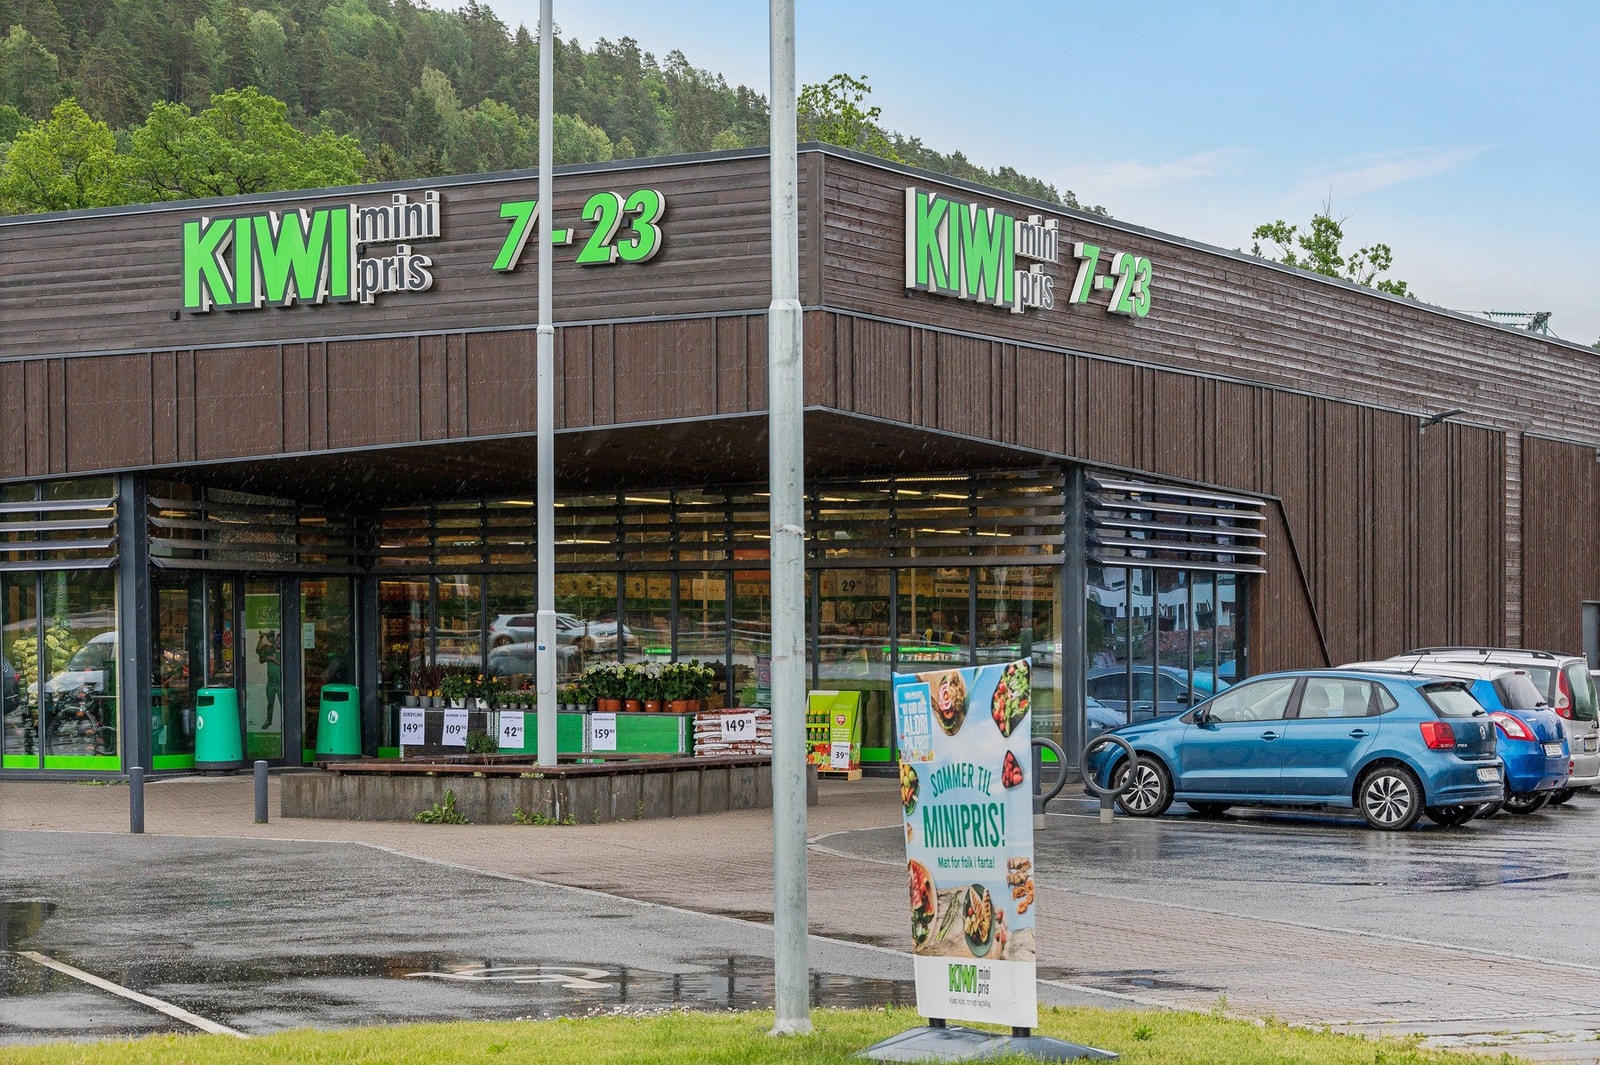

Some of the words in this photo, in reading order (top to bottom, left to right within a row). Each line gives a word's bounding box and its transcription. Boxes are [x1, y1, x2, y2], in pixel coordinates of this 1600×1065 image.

[358, 190, 440, 242] mini
[905, 187, 1015, 308] KIWI
[1015, 214, 1059, 263] mini
[181, 203, 357, 314] KIWI
[358, 245, 434, 304] pris
[1011, 263, 1055, 314] pris
[403, 723, 418, 733] 149
[446, 724, 461, 734] 109
[594, 728, 609, 739] 159
[725, 719, 745, 732] 149
[904, 714, 928, 735] ALDRI
[930, 762, 974, 798] SOMMER
[978, 766, 991, 797] TIL
[922, 802, 1006, 848] MINIPRIS!
[938, 856, 951, 868] Mat
[951, 856, 961, 868] for
[961, 856, 973, 868] folk
[977, 856, 995, 868] farta!
[948, 963, 977, 994] KIWI
[977, 980, 990, 997] pris
[978, 966, 991, 980] mini
